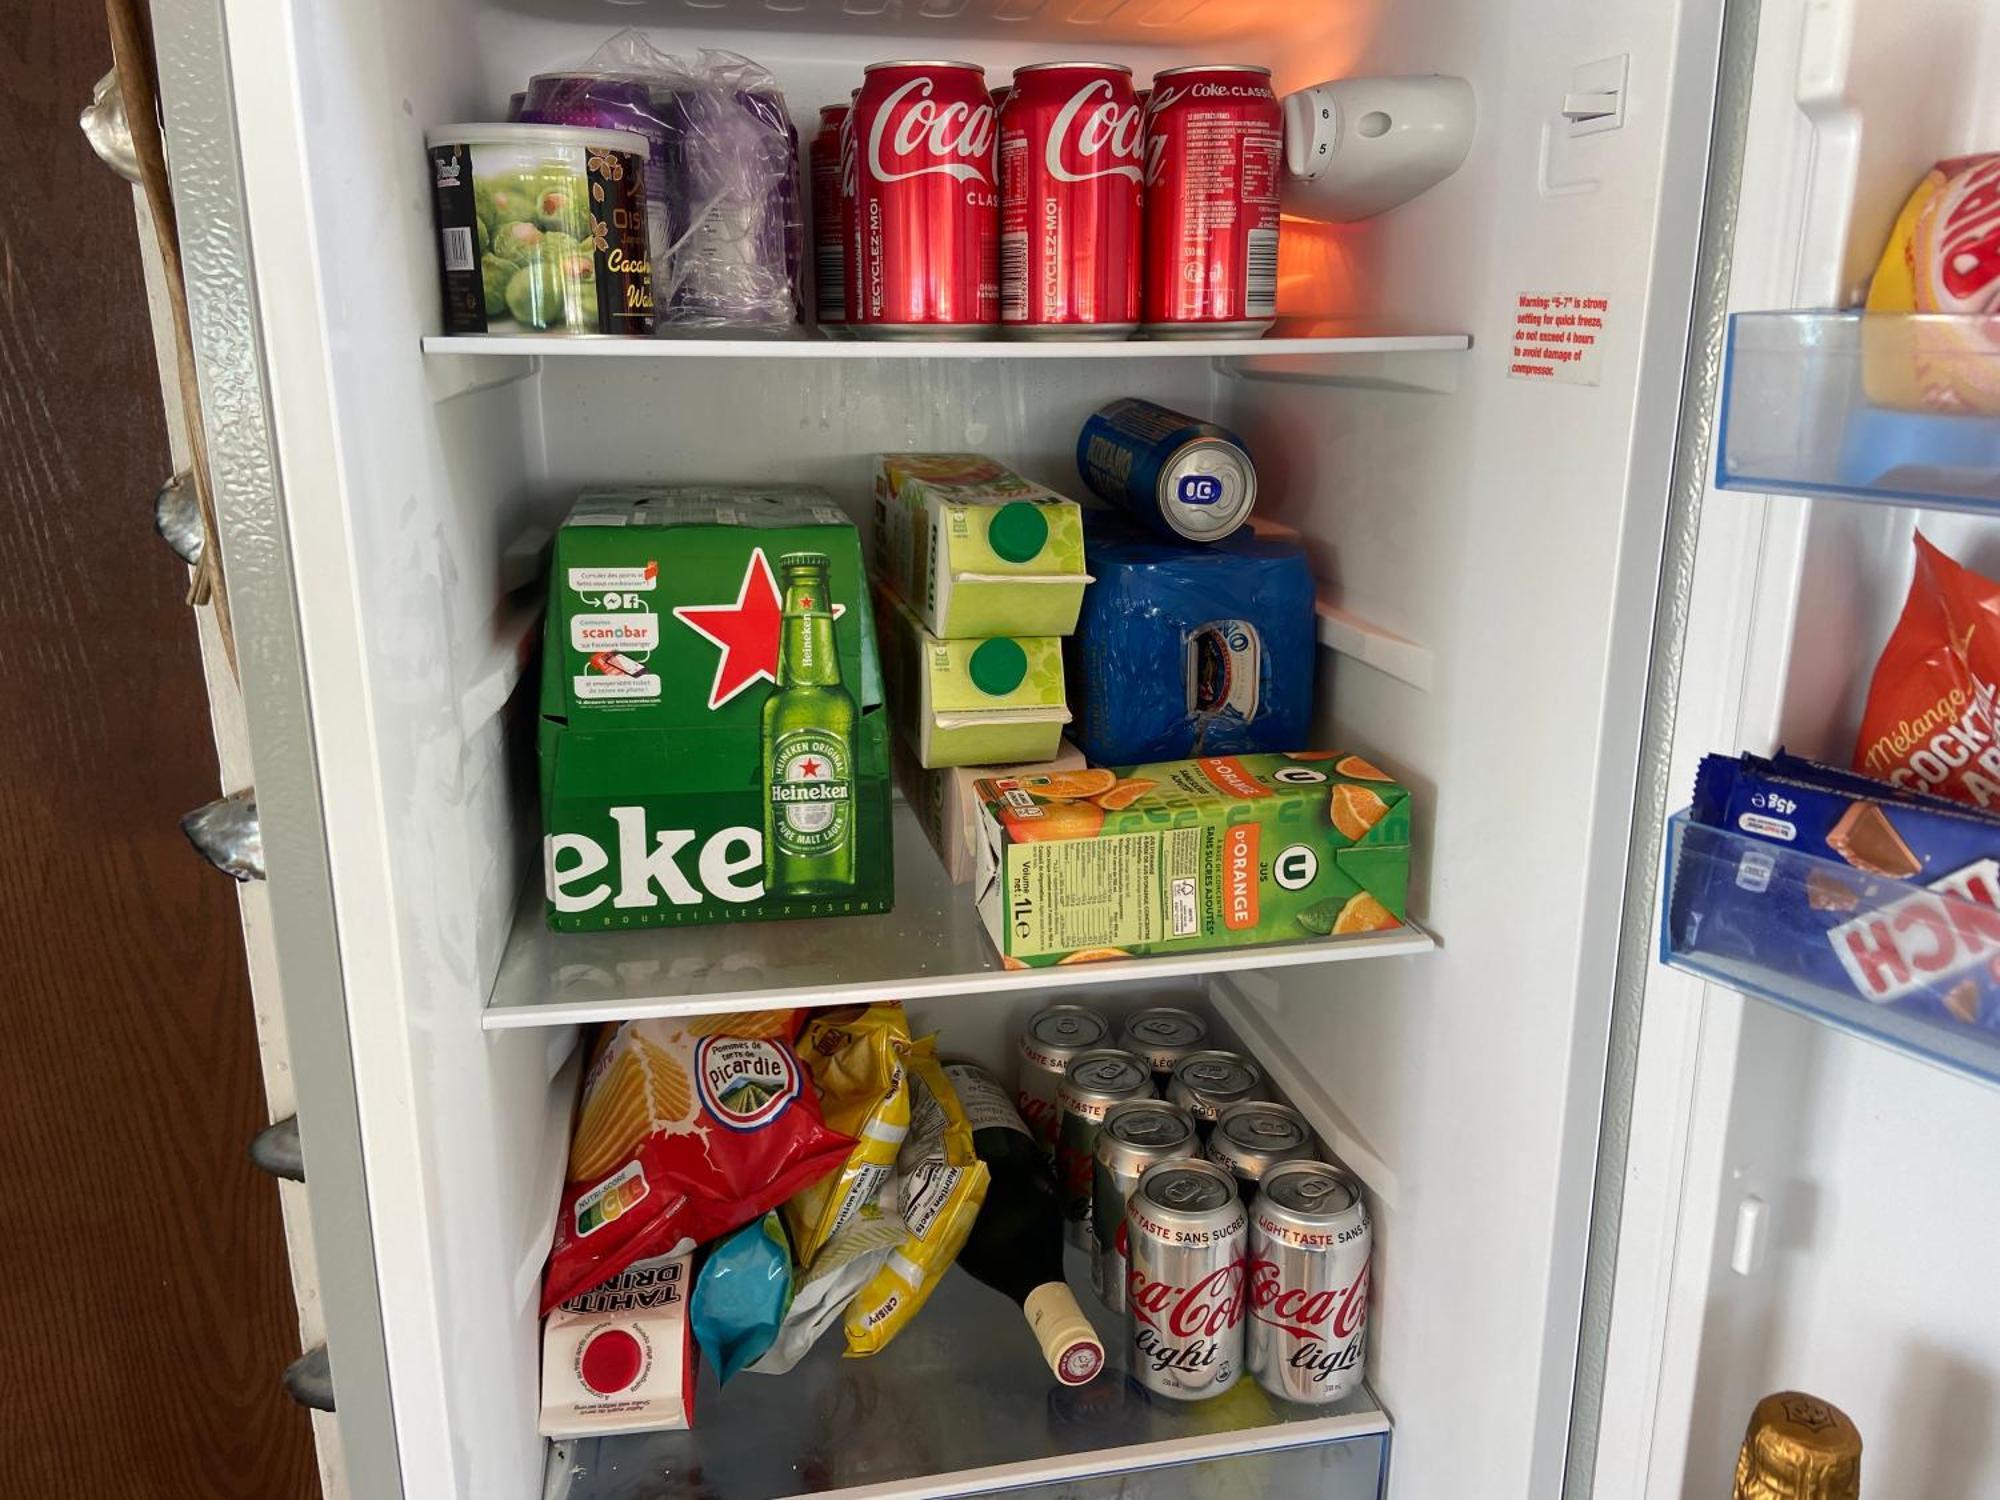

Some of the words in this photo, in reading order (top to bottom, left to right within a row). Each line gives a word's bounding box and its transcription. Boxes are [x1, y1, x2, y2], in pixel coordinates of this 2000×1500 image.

[1191, 83, 1228, 97] Coke
[1322, 108, 1329, 119] 6
[1319, 143, 1328, 155] 5
[869, 197, 881, 318] RECYCLEZ-MOI
[1045, 197, 1058, 318] RECYCLEZ-MOI
[1574, 297, 1582, 309] is
[1583, 298, 1608, 312] strong
[1517, 313, 1542, 327] setting
[1543, 313, 1554, 325] for
[1555, 314, 1576, 328] quick
[1515, 329, 1525, 341] do
[1526, 331, 1538, 341] not
[1539, 332, 1565, 343] exceed
[1566, 332, 1572, 343] 4
[1573, 332, 1595, 345] hours
[1514, 346, 1521, 357] to
[1522, 347, 1542, 358] avoid
[1543, 348, 1572, 363] damage
[1573, 350, 1582, 361] of
[582, 625, 648, 639] scanobar
[802, 613, 811, 667] Heineken
[1864, 688, 1966, 772] Mélange
[776, 742, 809, 775] HEINEKEN
[812, 742, 844, 773] ORIGINAL
[771, 783, 849, 802] Heineken
[777, 821, 797, 841] PURE
[796, 834, 821, 844] MALT
[823, 818, 843, 841] LAGER
[1206, 826, 1216, 850] SANS
[545, 806, 766, 913] eke
[1205, 850, 1214, 887] SUCRES
[1259, 862, 1269, 883] JUS
[1283, 854, 1307, 881] U
[1022, 861, 1031, 894] Volume
[1233, 831, 1249, 923] D'ORANGE
[604, 907, 764, 926] BOUTEILLES
[711, 1042, 749, 1056] Pommes
[709, 1056, 782, 1091] Picardie
[934, 1167, 958, 1207] Nutrition
[915, 1207, 936, 1234] Facts
[1139, 1215, 1171, 1240] TASTE
[1174, 1231, 1209, 1243] SANS
[1258, 1215, 1290, 1239] LIGHT
[1292, 1231, 1335, 1246] TASTE
[1337, 1225, 1364, 1244] SANS
[1135, 1329, 1218, 1373] light
